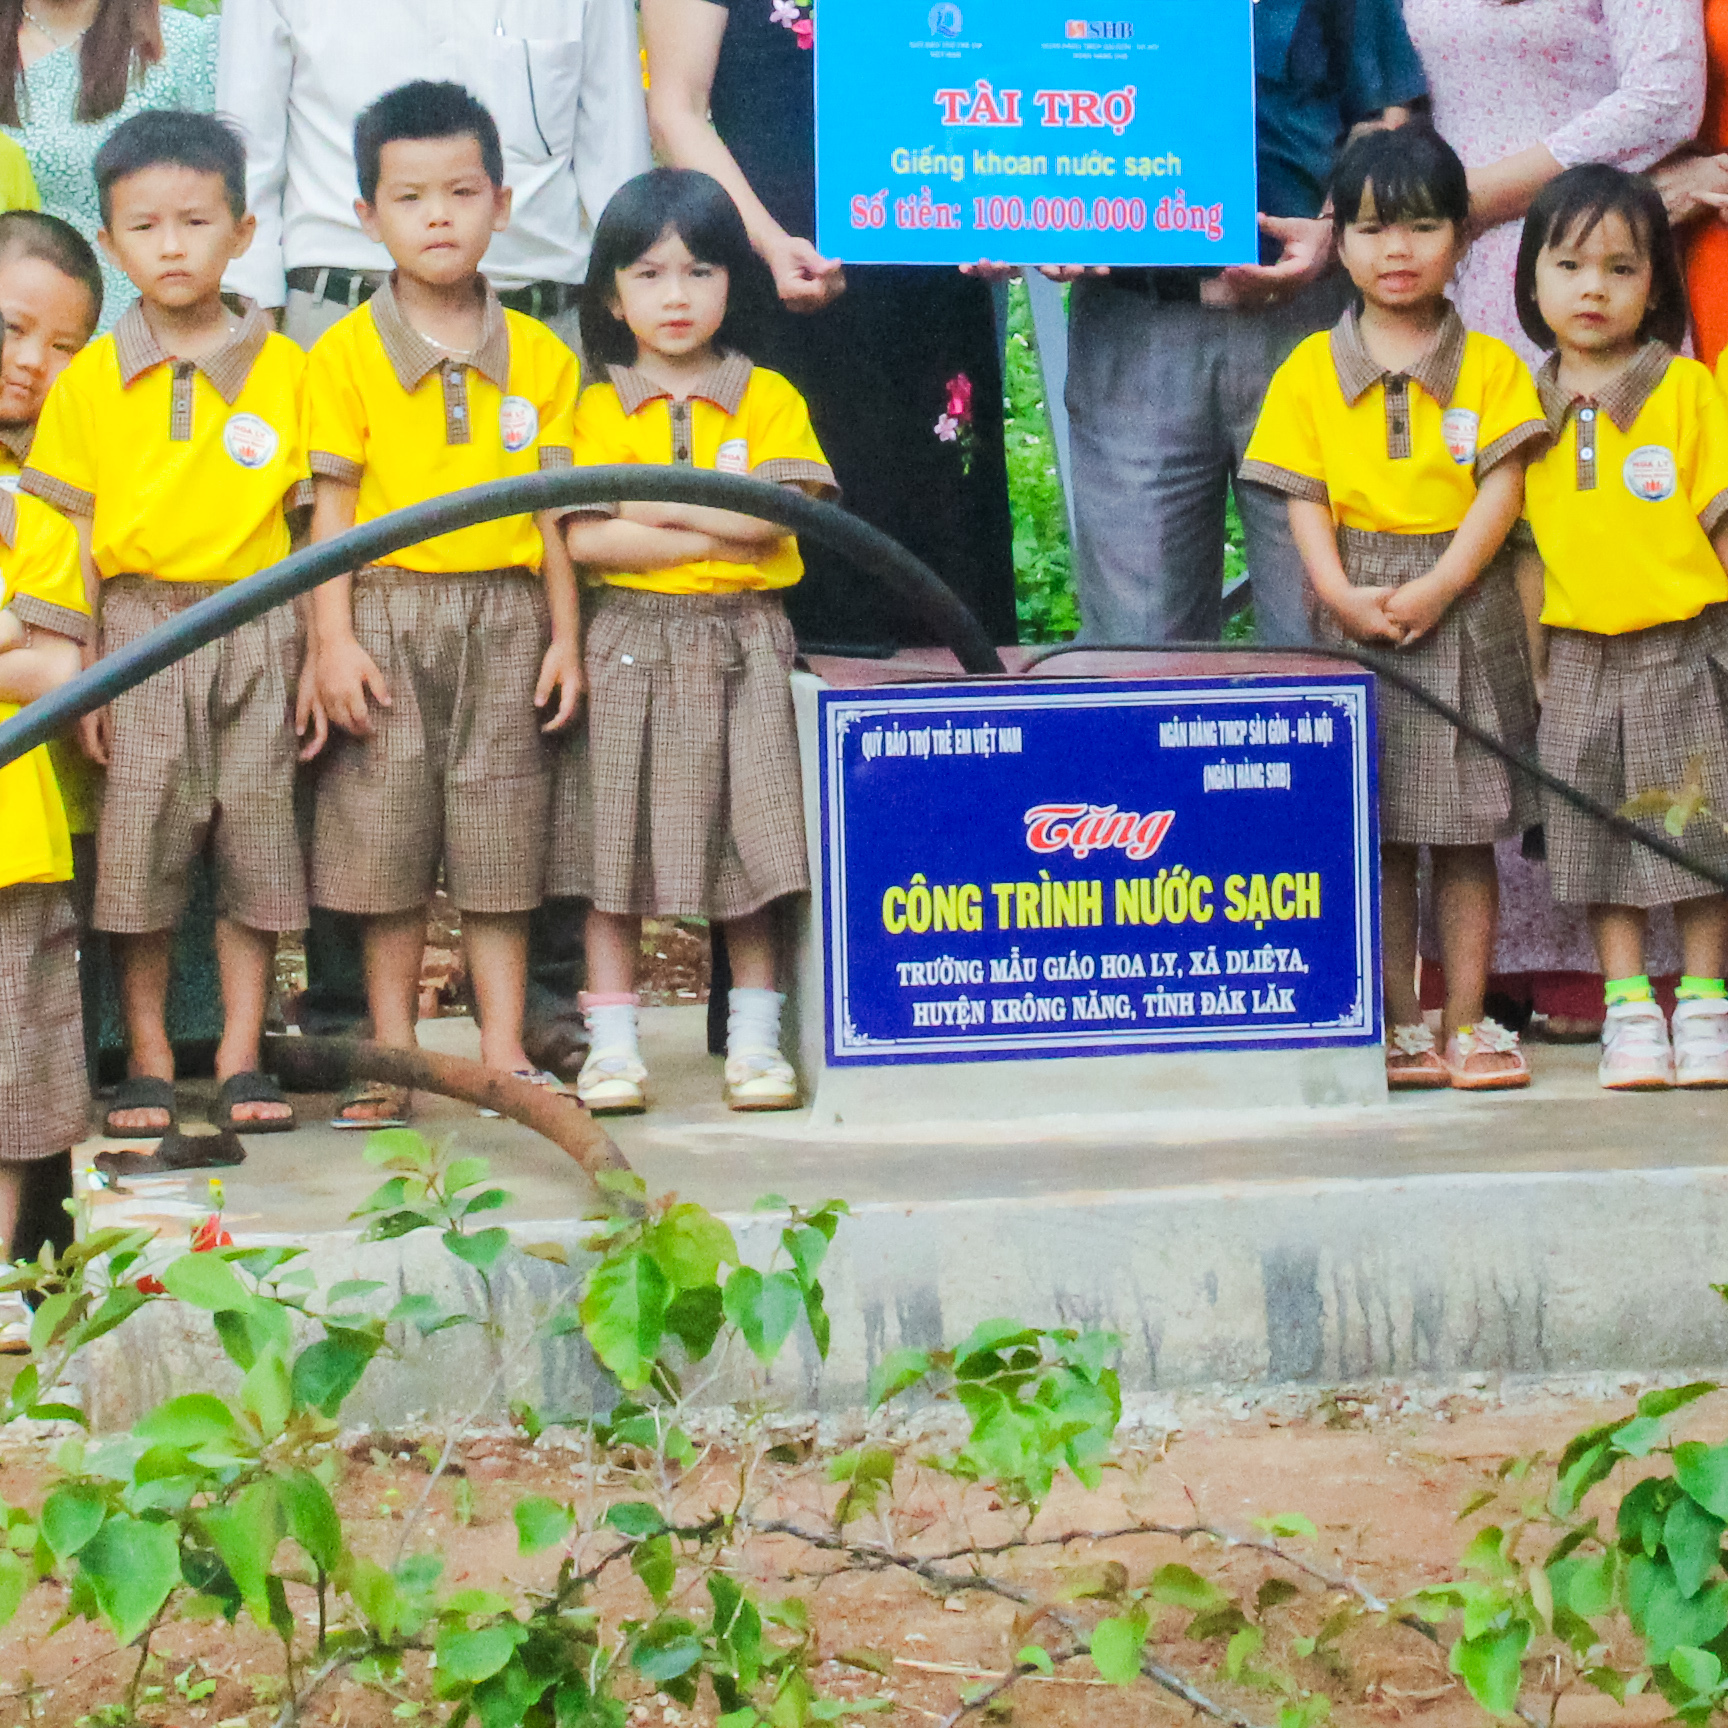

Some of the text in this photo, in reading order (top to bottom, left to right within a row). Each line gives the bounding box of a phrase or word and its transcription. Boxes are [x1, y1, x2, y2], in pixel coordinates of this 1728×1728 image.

[1087, 21, 1133, 39] SHB
[936, 79, 1136, 134] TÀI TRỢ
[891, 145, 1182, 181] Giếng khoan nước sạch
[850, 186, 1223, 241] Số tiền: 100.000.000 đồng
[1023, 803, 1175, 861] Tặng
[882, 864, 1321, 934] CÔNG TRÌNH NƯỚC SẠCH
[896, 943, 1310, 987] TRƯỜNG MẪU GIÁO HOA LY, XÃ DLIÊYA,
[912, 984, 1296, 1031] HUYỆN KRÔNG NĂNG, TỈNH ĐĂK LĂK
